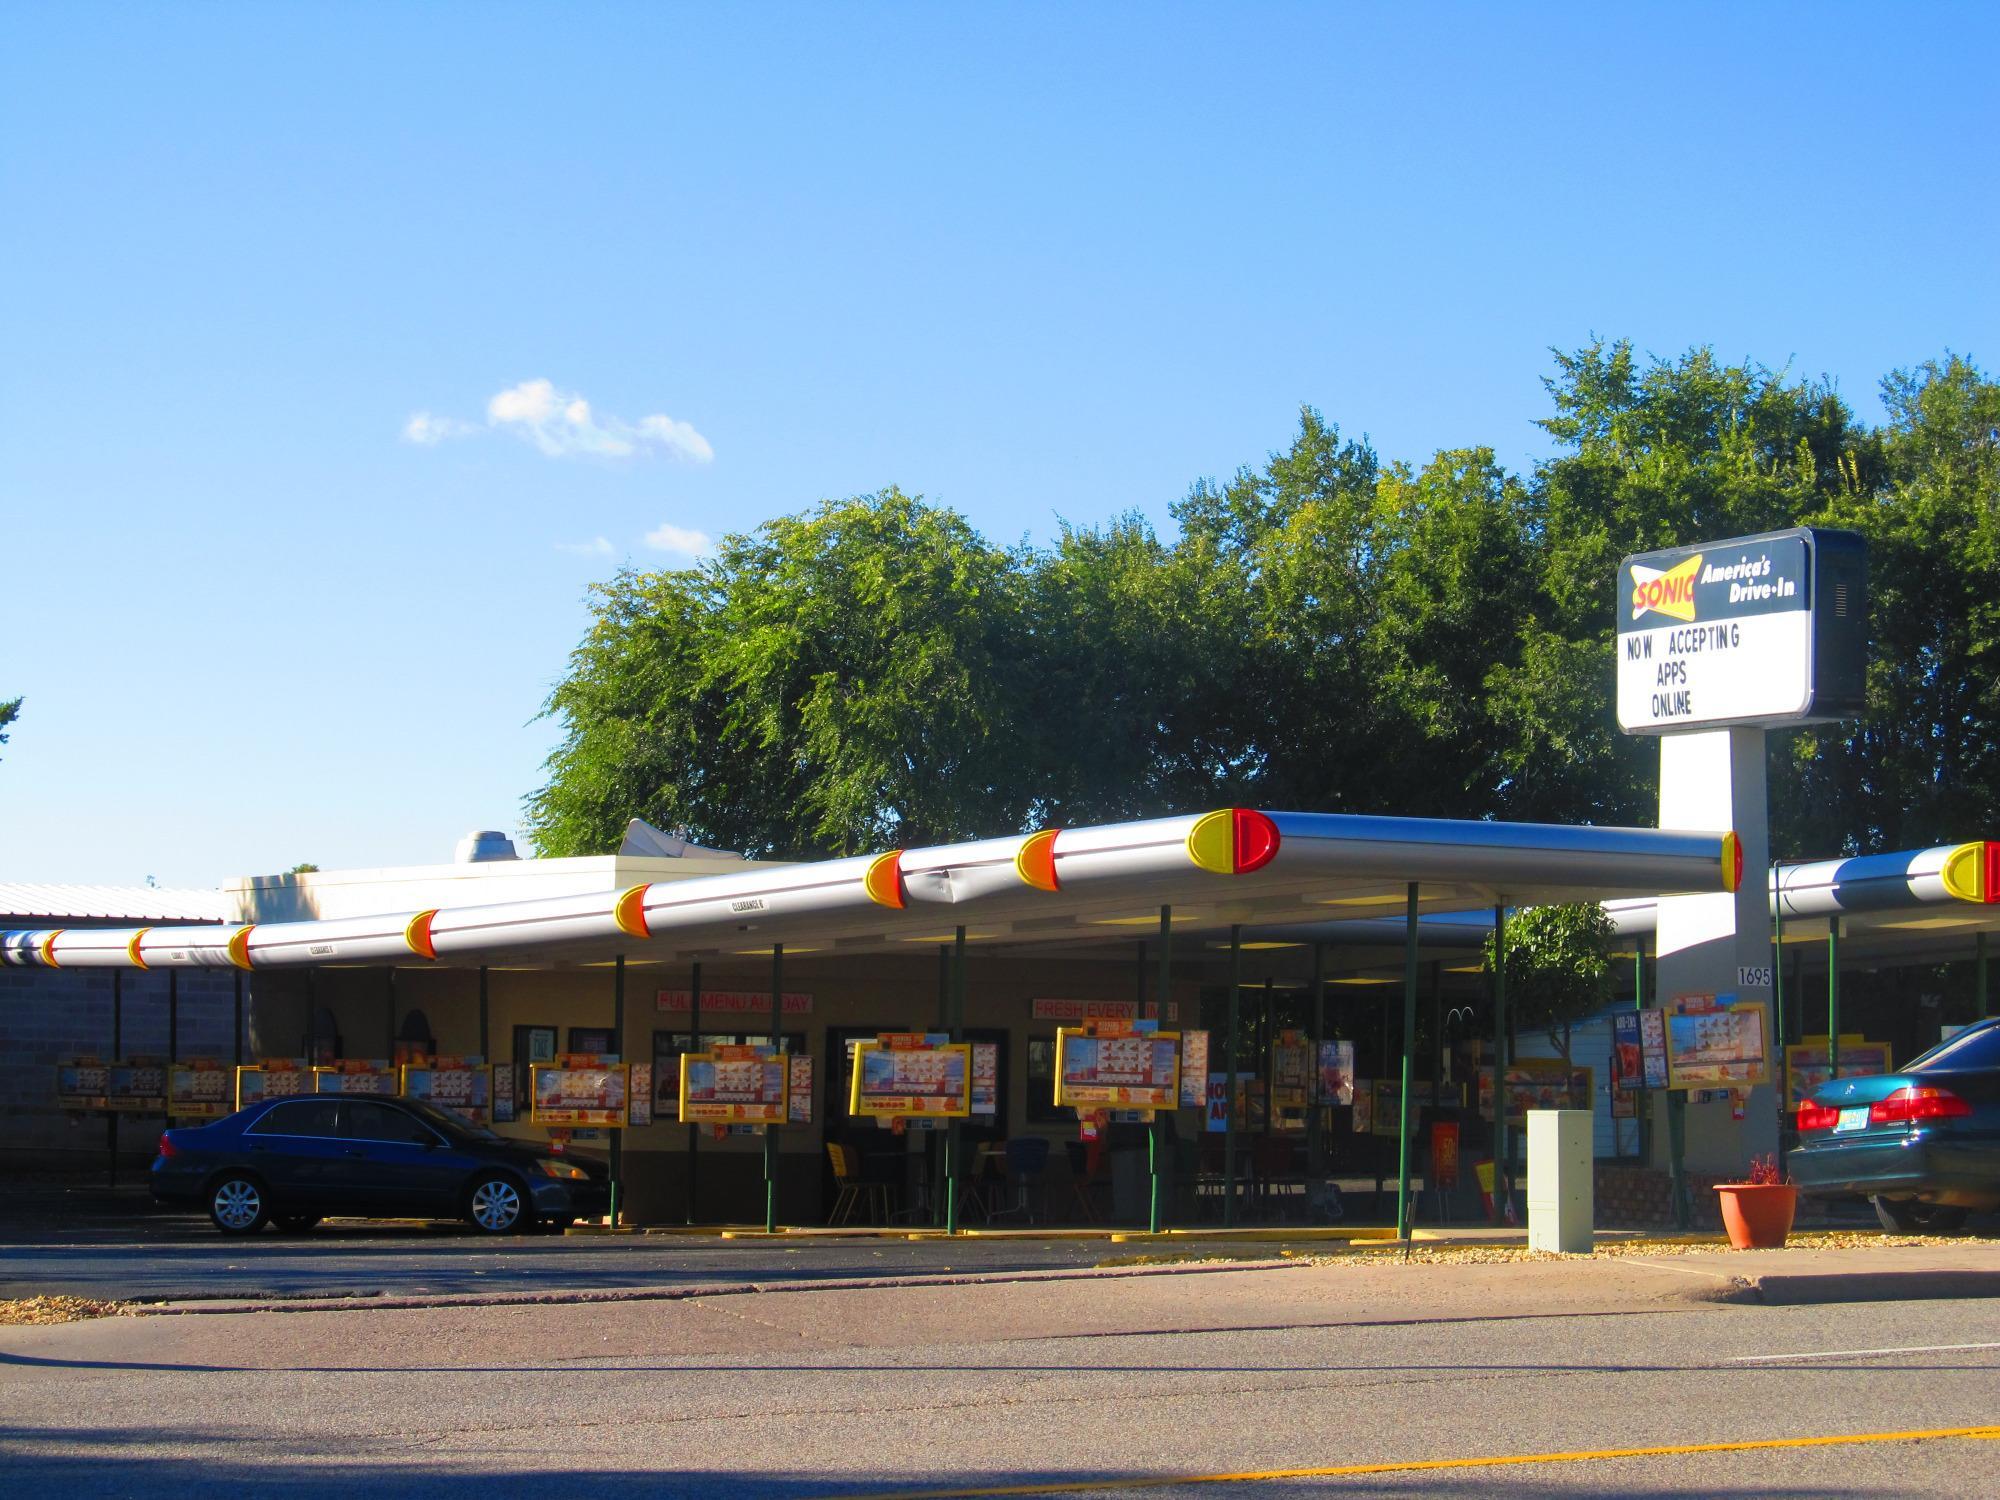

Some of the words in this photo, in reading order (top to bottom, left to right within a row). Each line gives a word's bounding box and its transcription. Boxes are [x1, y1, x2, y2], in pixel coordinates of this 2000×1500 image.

[1701, 554, 1771, 584] America's
[1635, 574, 1695, 609] SONIC
[1627, 634, 1653, 661] NOW
[1668, 623, 1740, 655] ACCEPTING
[1657, 660, 1687, 687] APPS
[1652, 690, 1692, 719] ONLINE
[1739, 967, 1771, 986] 1695
[700, 993, 745, 1010] MENU
[1035, 1001, 1083, 1018] FRESH
[1087, 1002, 1134, 1019] EVERY
